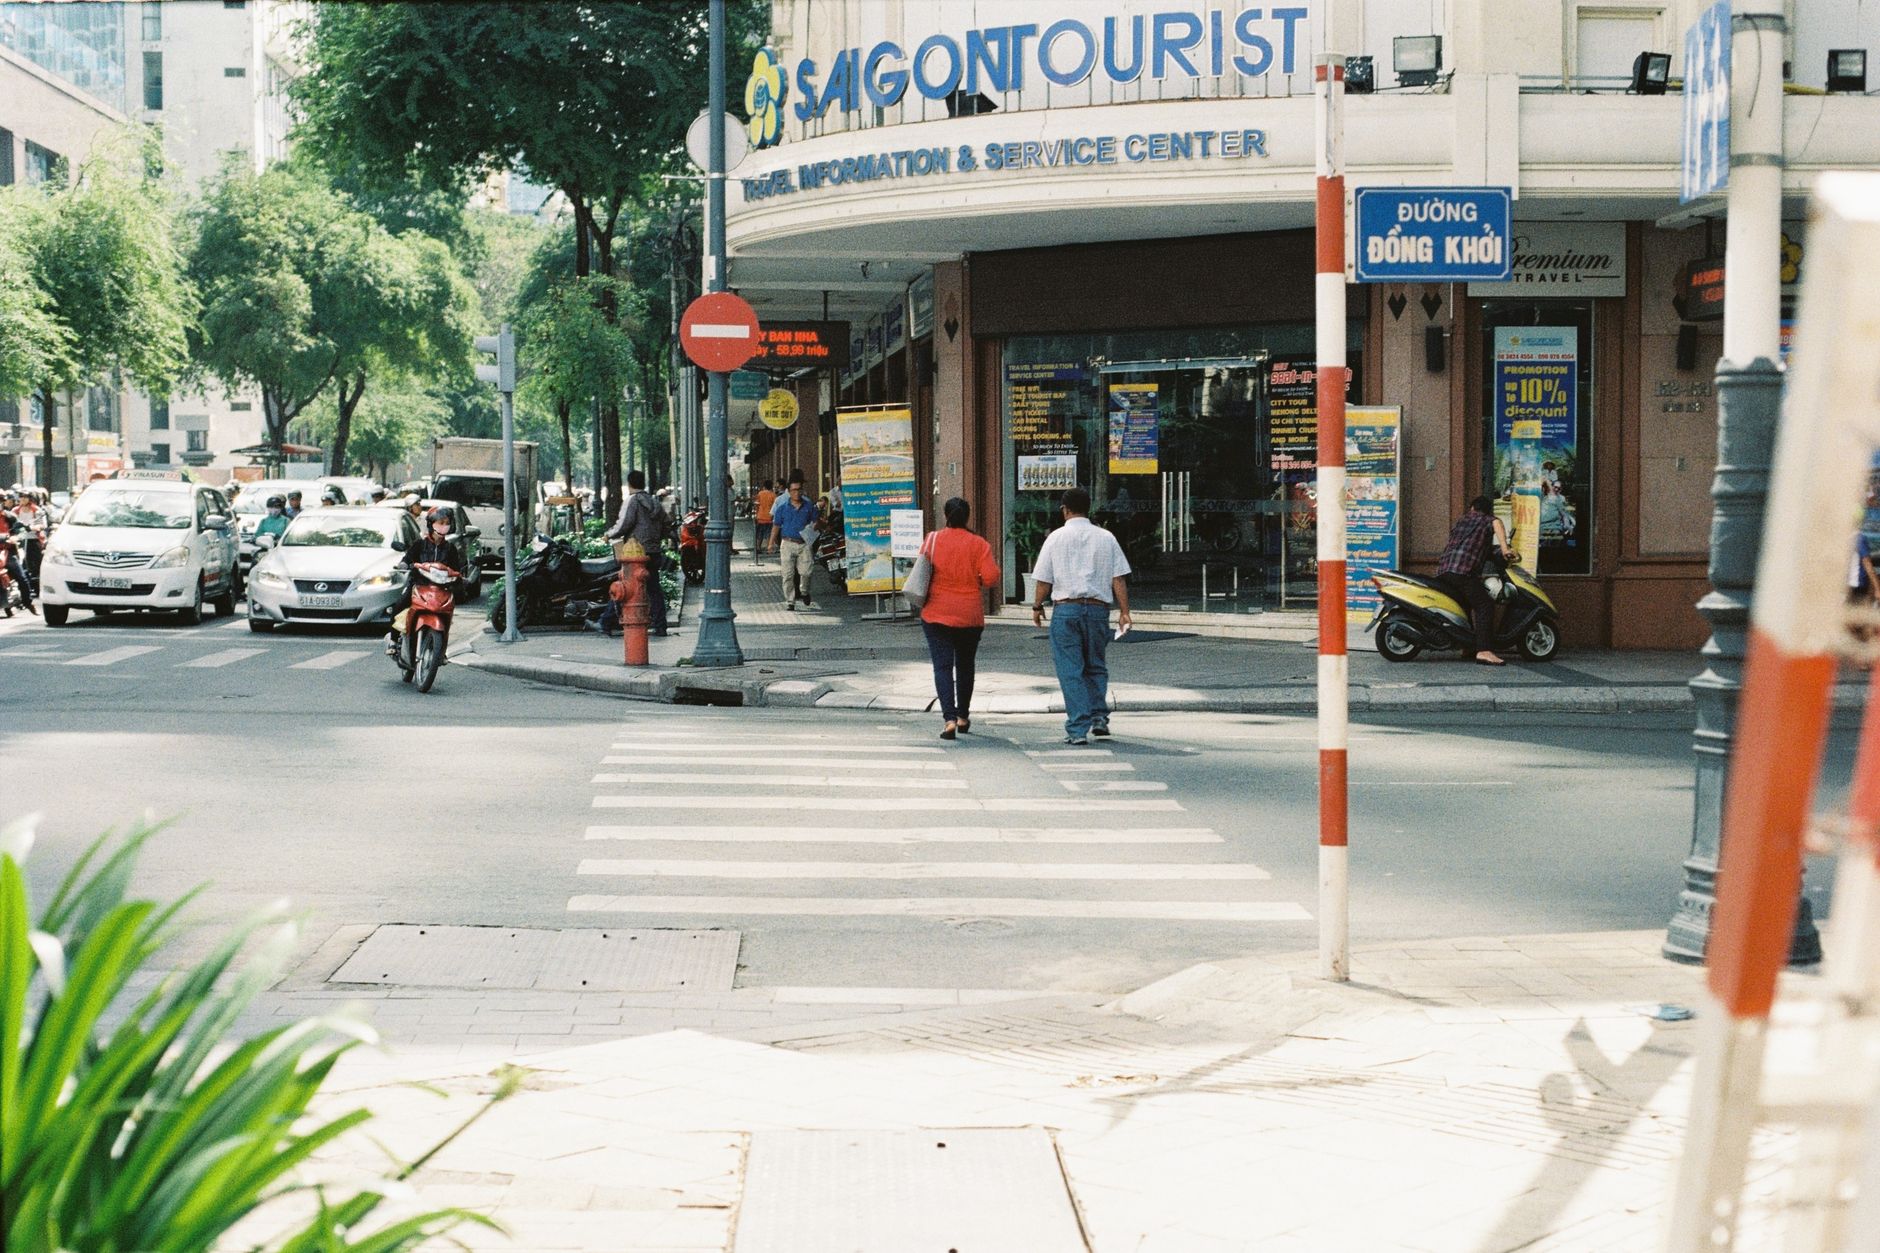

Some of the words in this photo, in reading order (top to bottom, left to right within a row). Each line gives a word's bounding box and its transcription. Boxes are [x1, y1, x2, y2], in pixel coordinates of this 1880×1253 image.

[794, 7, 1309, 122] SAIGONTOURIST
[741, 168, 798, 202] TRAVEL
[799, 147, 950, 191] INFORMATION
[957, 145, 978, 173] &
[985, 136, 1118, 170] SERVICE
[1124, 129, 1267, 162] CENTER
[1398, 197, 1478, 223] ĐƯỜNG
[1367, 224, 1434, 265] ĐỒNG
[1445, 223, 1503, 265] KHỞI
[1515, 273, 1582, 283] TRAVEL
[1504, 366, 1568, 375] PROMOTION
[1520, 378, 1567, 404] 10%
[1505, 404, 1568, 417] discount
[132, 471, 166, 479] VINASUN
